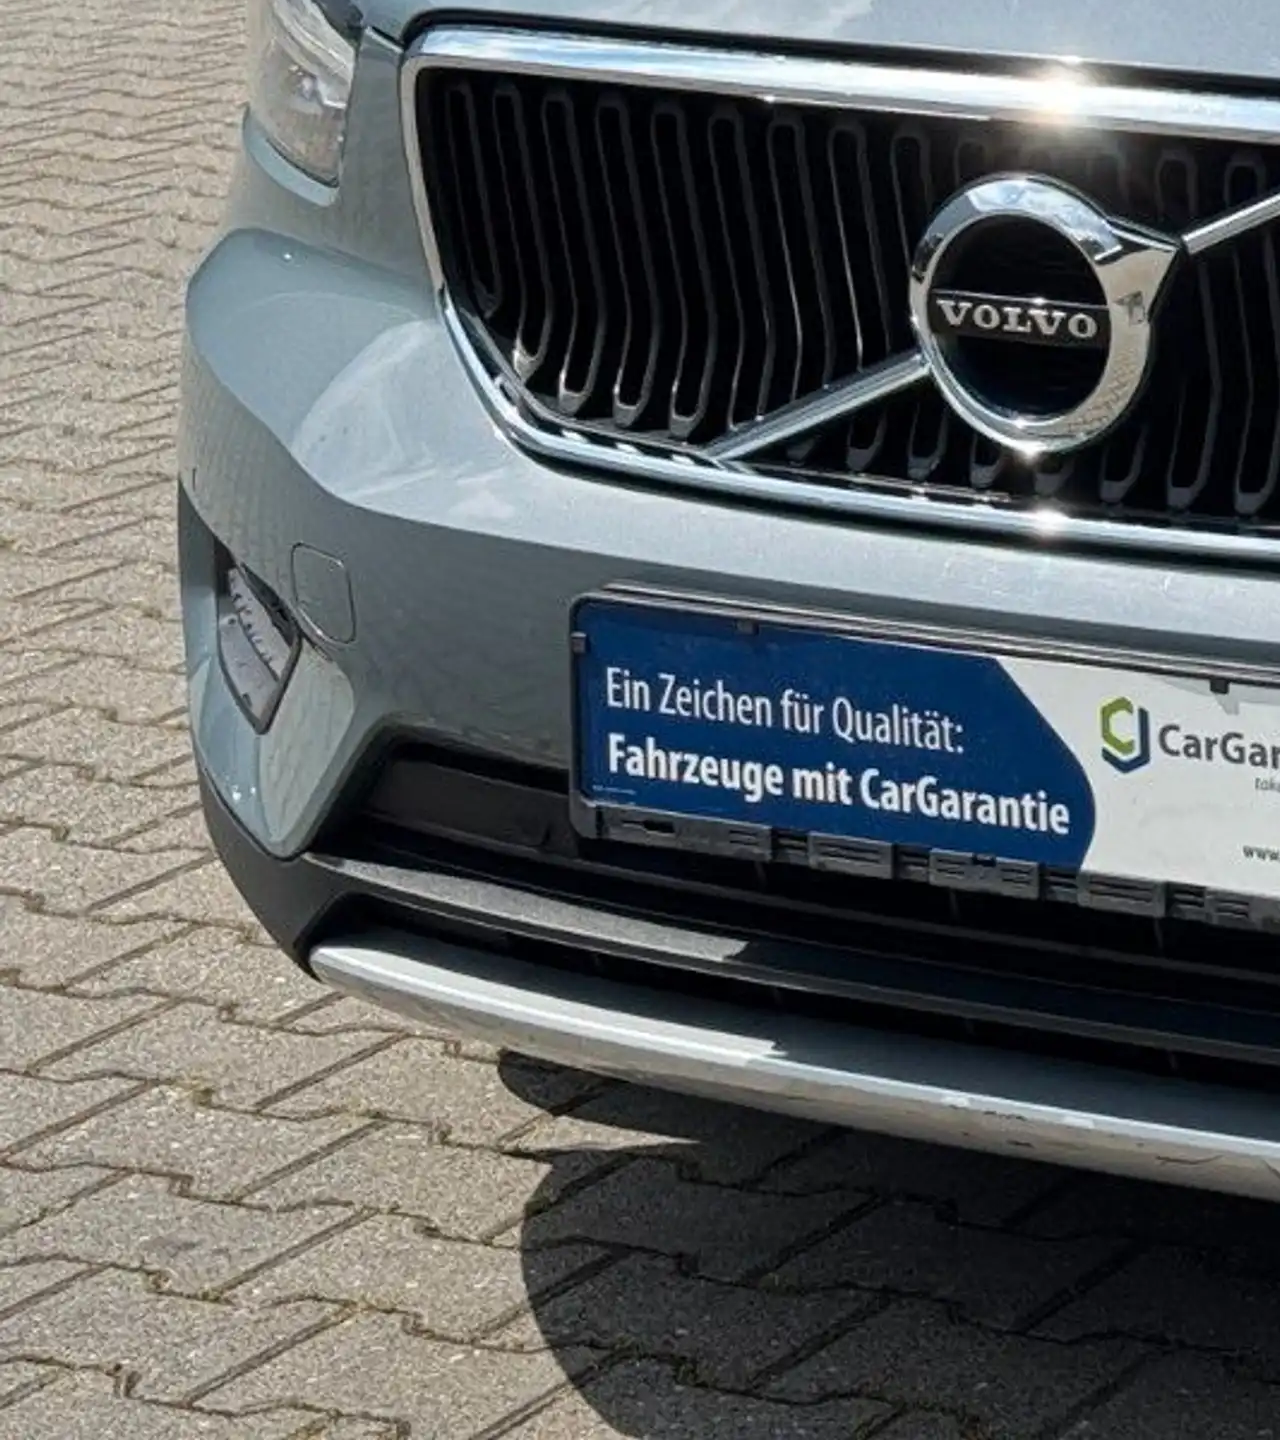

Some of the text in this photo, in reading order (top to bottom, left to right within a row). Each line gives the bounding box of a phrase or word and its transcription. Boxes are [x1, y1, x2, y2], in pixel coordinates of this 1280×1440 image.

[937, 299, 1099, 339] VOLVO
[606, 667, 964, 754] Ein Zeichen für Qualität:
[608, 734, 1070, 835] Fahrzeuge mit CarGarantie
